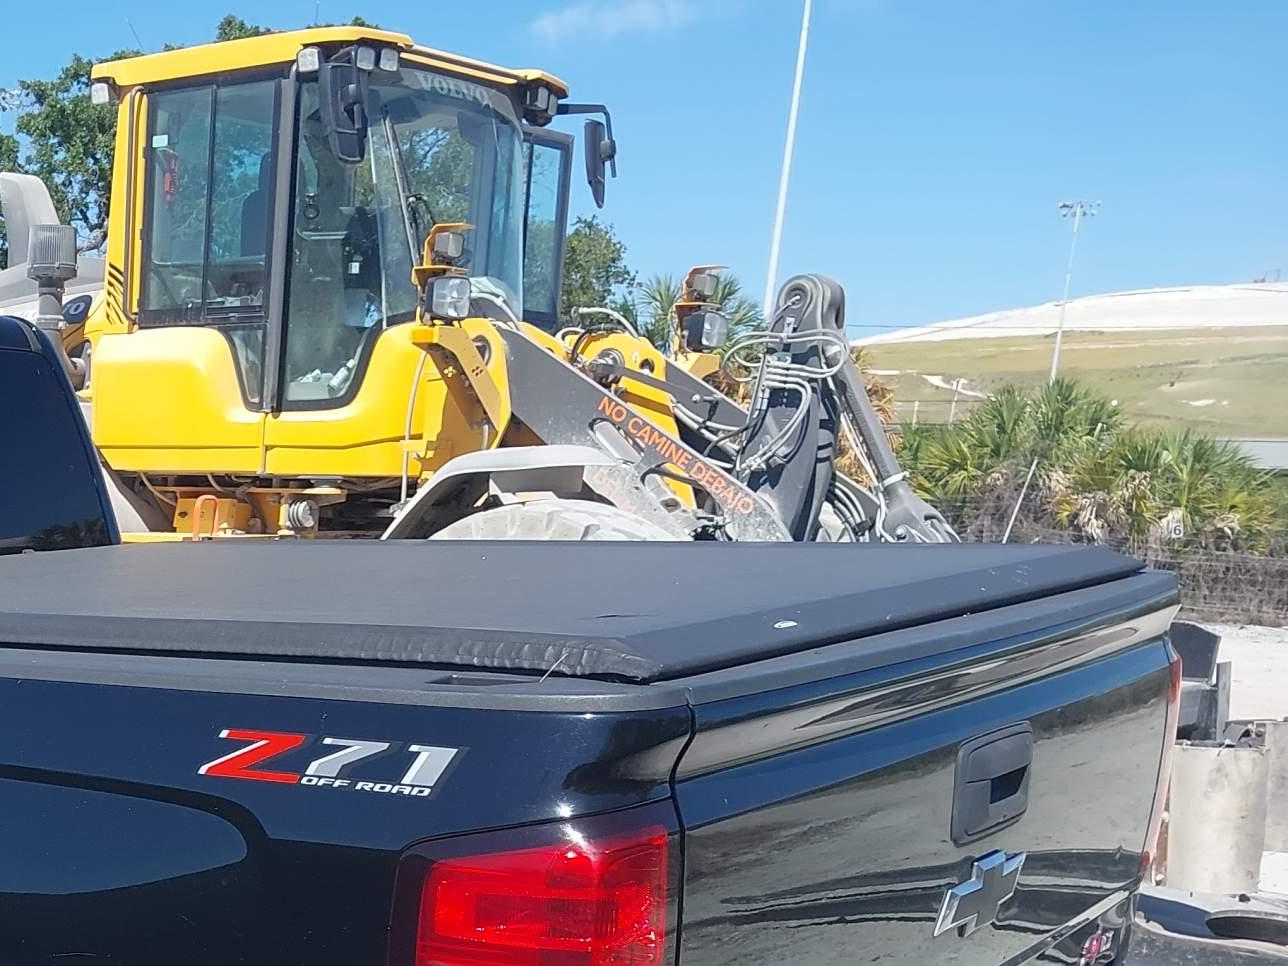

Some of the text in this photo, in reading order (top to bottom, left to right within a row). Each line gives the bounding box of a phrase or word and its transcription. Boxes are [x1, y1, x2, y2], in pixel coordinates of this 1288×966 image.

[416, 71, 490, 104] VOLVO
[598, 396, 627, 422] NO
[628, 417, 692, 473] CAMINE
[689, 463, 754, 514] DEBAJO
[1173, 524, 1183, 536] 6
[197, 728, 459, 787] Z71
[300, 775, 431, 797] OFF ROAD
